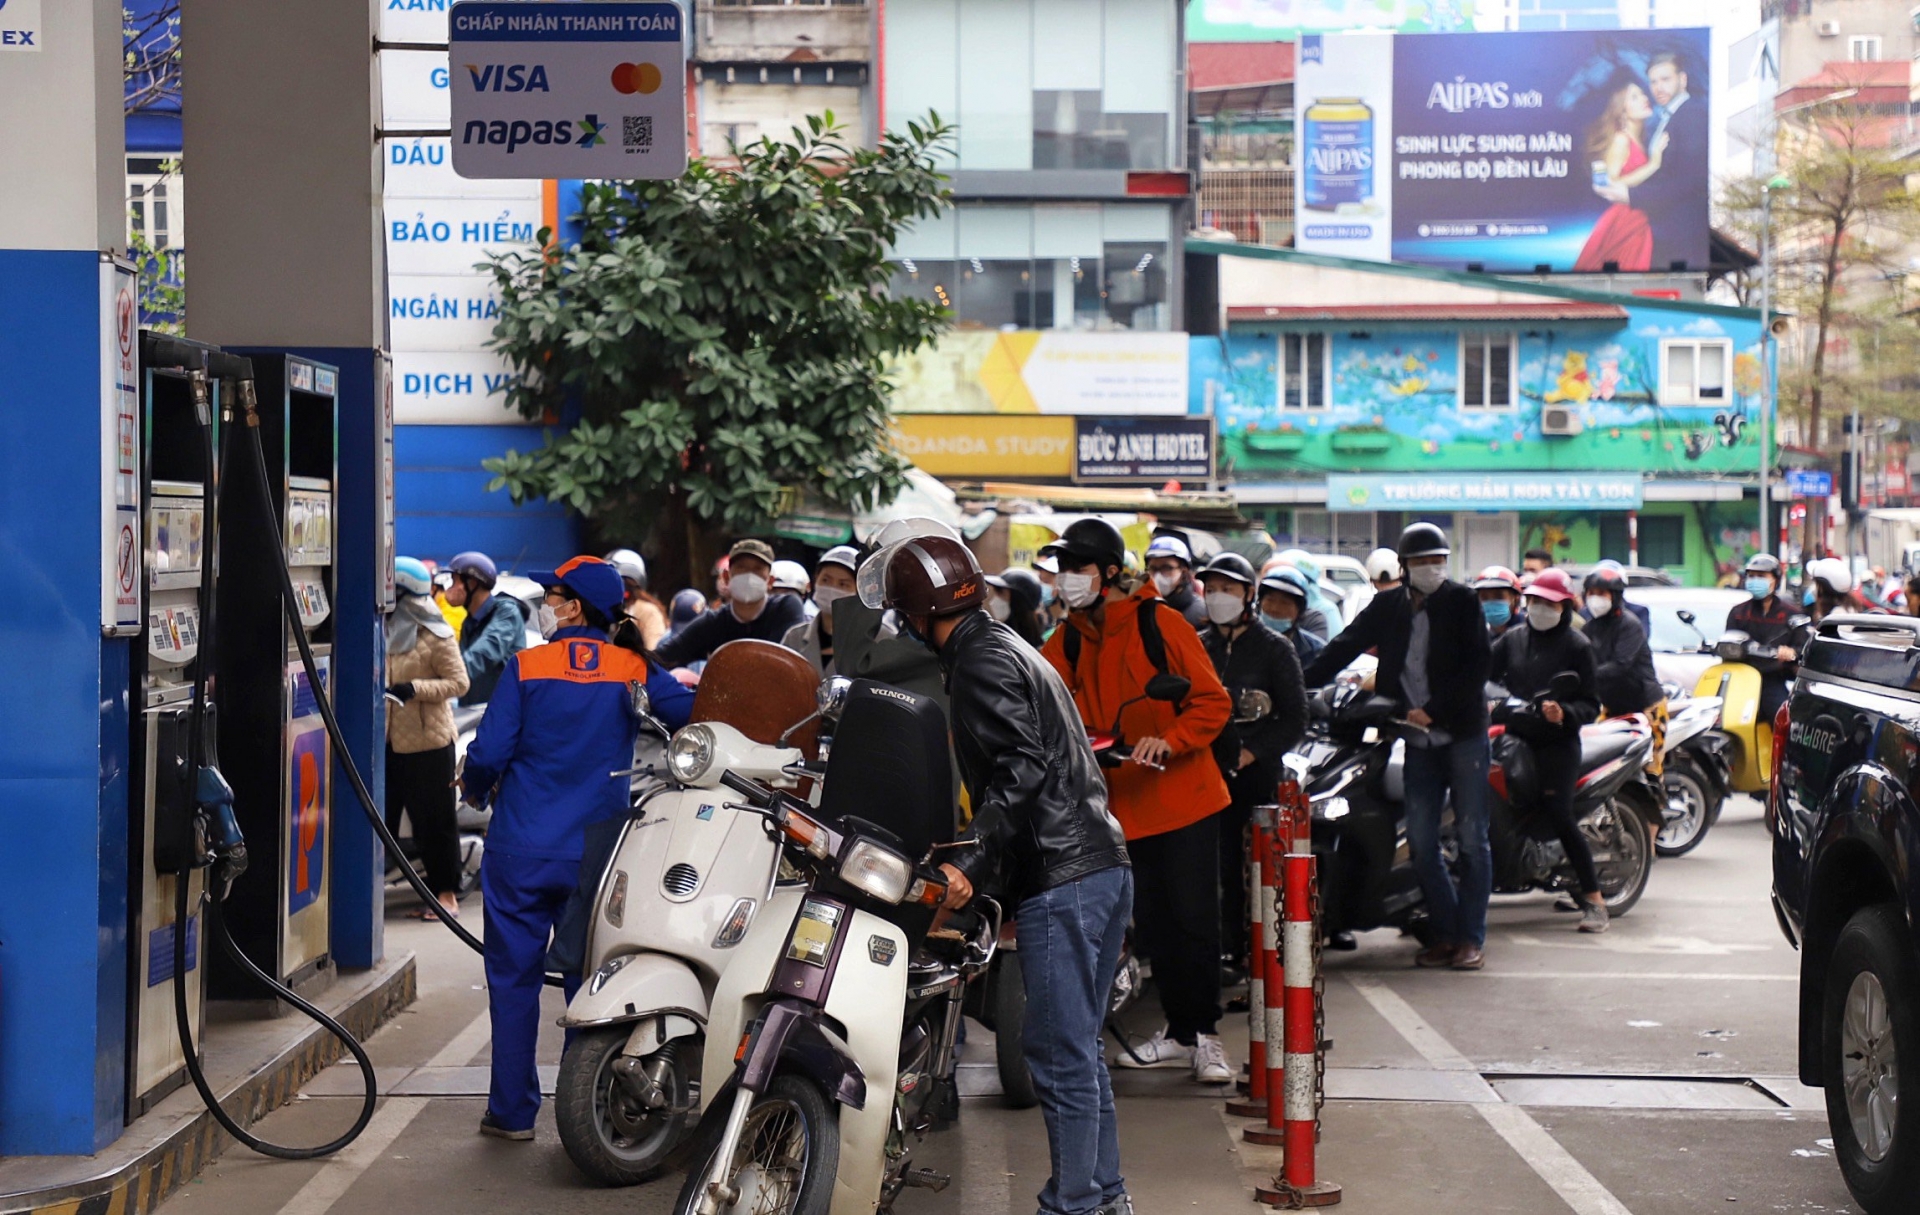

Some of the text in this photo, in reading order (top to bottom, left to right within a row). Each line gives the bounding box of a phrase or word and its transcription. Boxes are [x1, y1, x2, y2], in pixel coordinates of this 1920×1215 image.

[456, 12, 675, 34] CHẤP NHẬN THANH TOÁN
[2, 30, 35, 45] EX
[463, 64, 549, 92] VISA
[1513, 90, 1542, 108] MỚI
[463, 119, 571, 153] napas
[1396, 131, 1572, 157] SINH LỰC SUNG MÃN
[1399, 157, 1567, 182] PHONG ĐỘ BỀN LÂU
[392, 210, 532, 242] BẢO HIỂM
[392, 293, 458, 319] NGÂN
[404, 374, 472, 399] DỊCH
[995, 435, 1069, 456] STUDY
[1079, 426, 1208, 462] ĐỨC ANH HOTEL
[1384, 480, 1462, 500] TRƯỜNG
[1514, 483, 1552, 499] NON
[1555, 480, 1592, 499] TÂY
[564, 671, 606, 679] PETROLIMEX
[869, 687, 916, 705] HONDA
[1790, 721, 1837, 754] CALIBRE
[920, 984, 943, 996] HONDA
